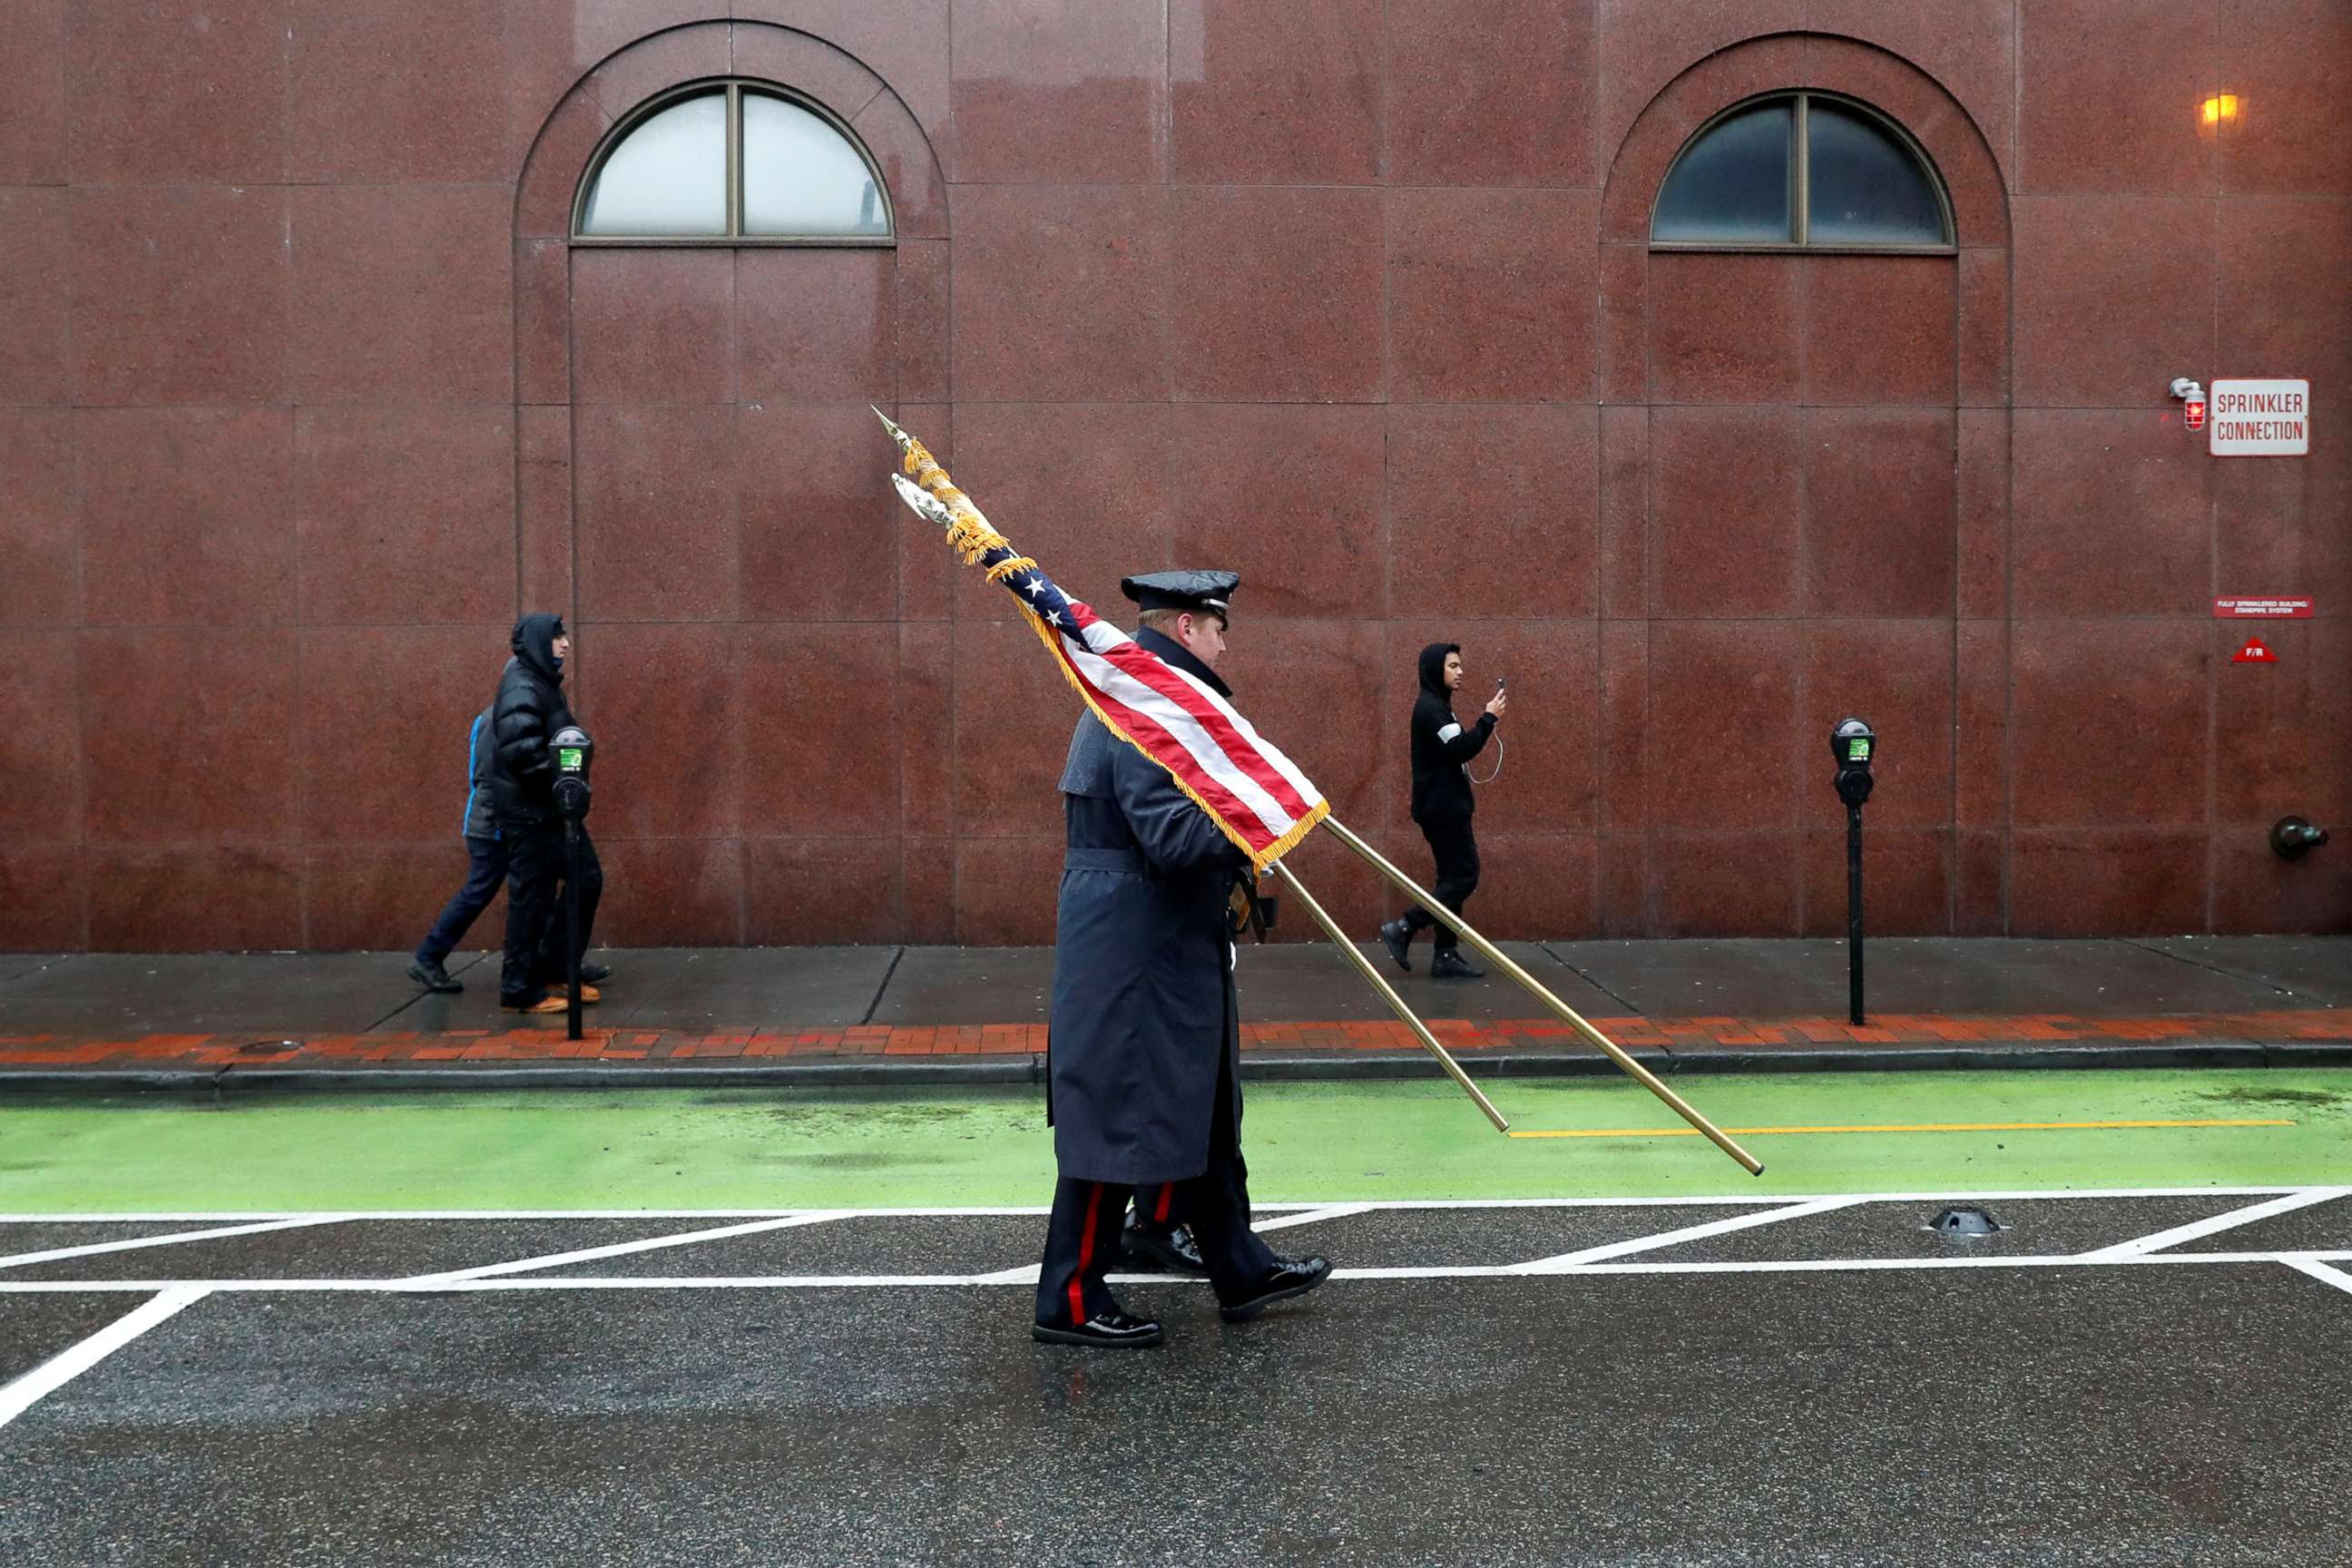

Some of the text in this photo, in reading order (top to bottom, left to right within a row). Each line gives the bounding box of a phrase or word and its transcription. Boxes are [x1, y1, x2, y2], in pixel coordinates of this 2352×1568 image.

[2218, 394, 2303, 413] SPRINKLER
[2218, 421, 2303, 440] CONNECTION
[2246, 648, 2264, 656] F/R
